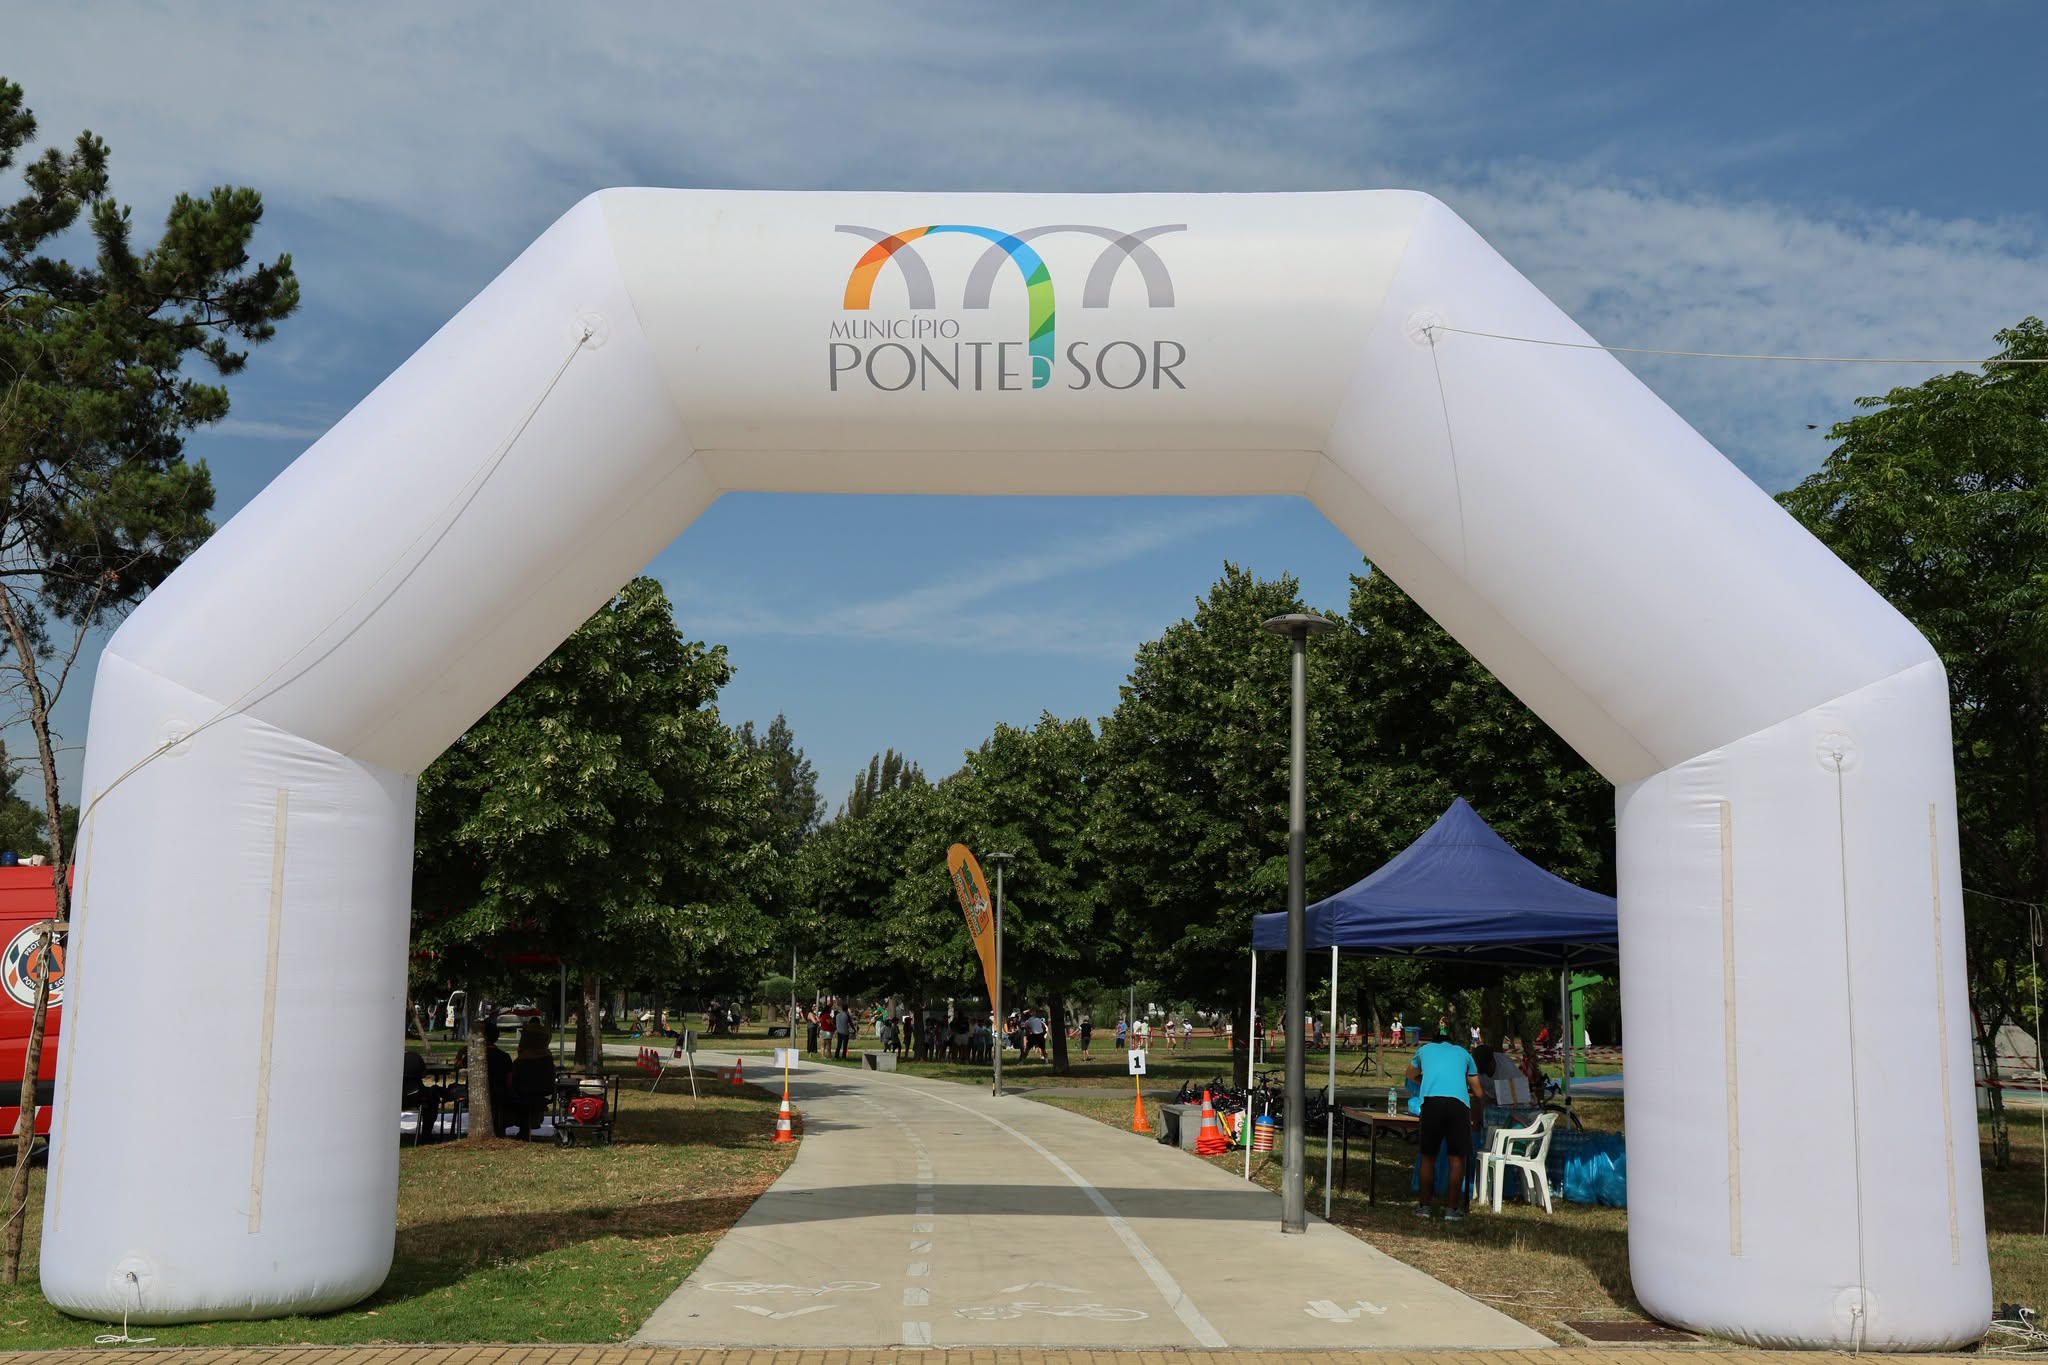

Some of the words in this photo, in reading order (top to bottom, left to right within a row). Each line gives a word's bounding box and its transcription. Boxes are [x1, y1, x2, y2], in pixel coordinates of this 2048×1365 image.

[829, 314, 960, 340] MUNICÍPIO
[828, 341, 1024, 392] PONTE
[1065, 340, 1187, 391] SOR
[1133, 1055, 1142, 1069] 1
